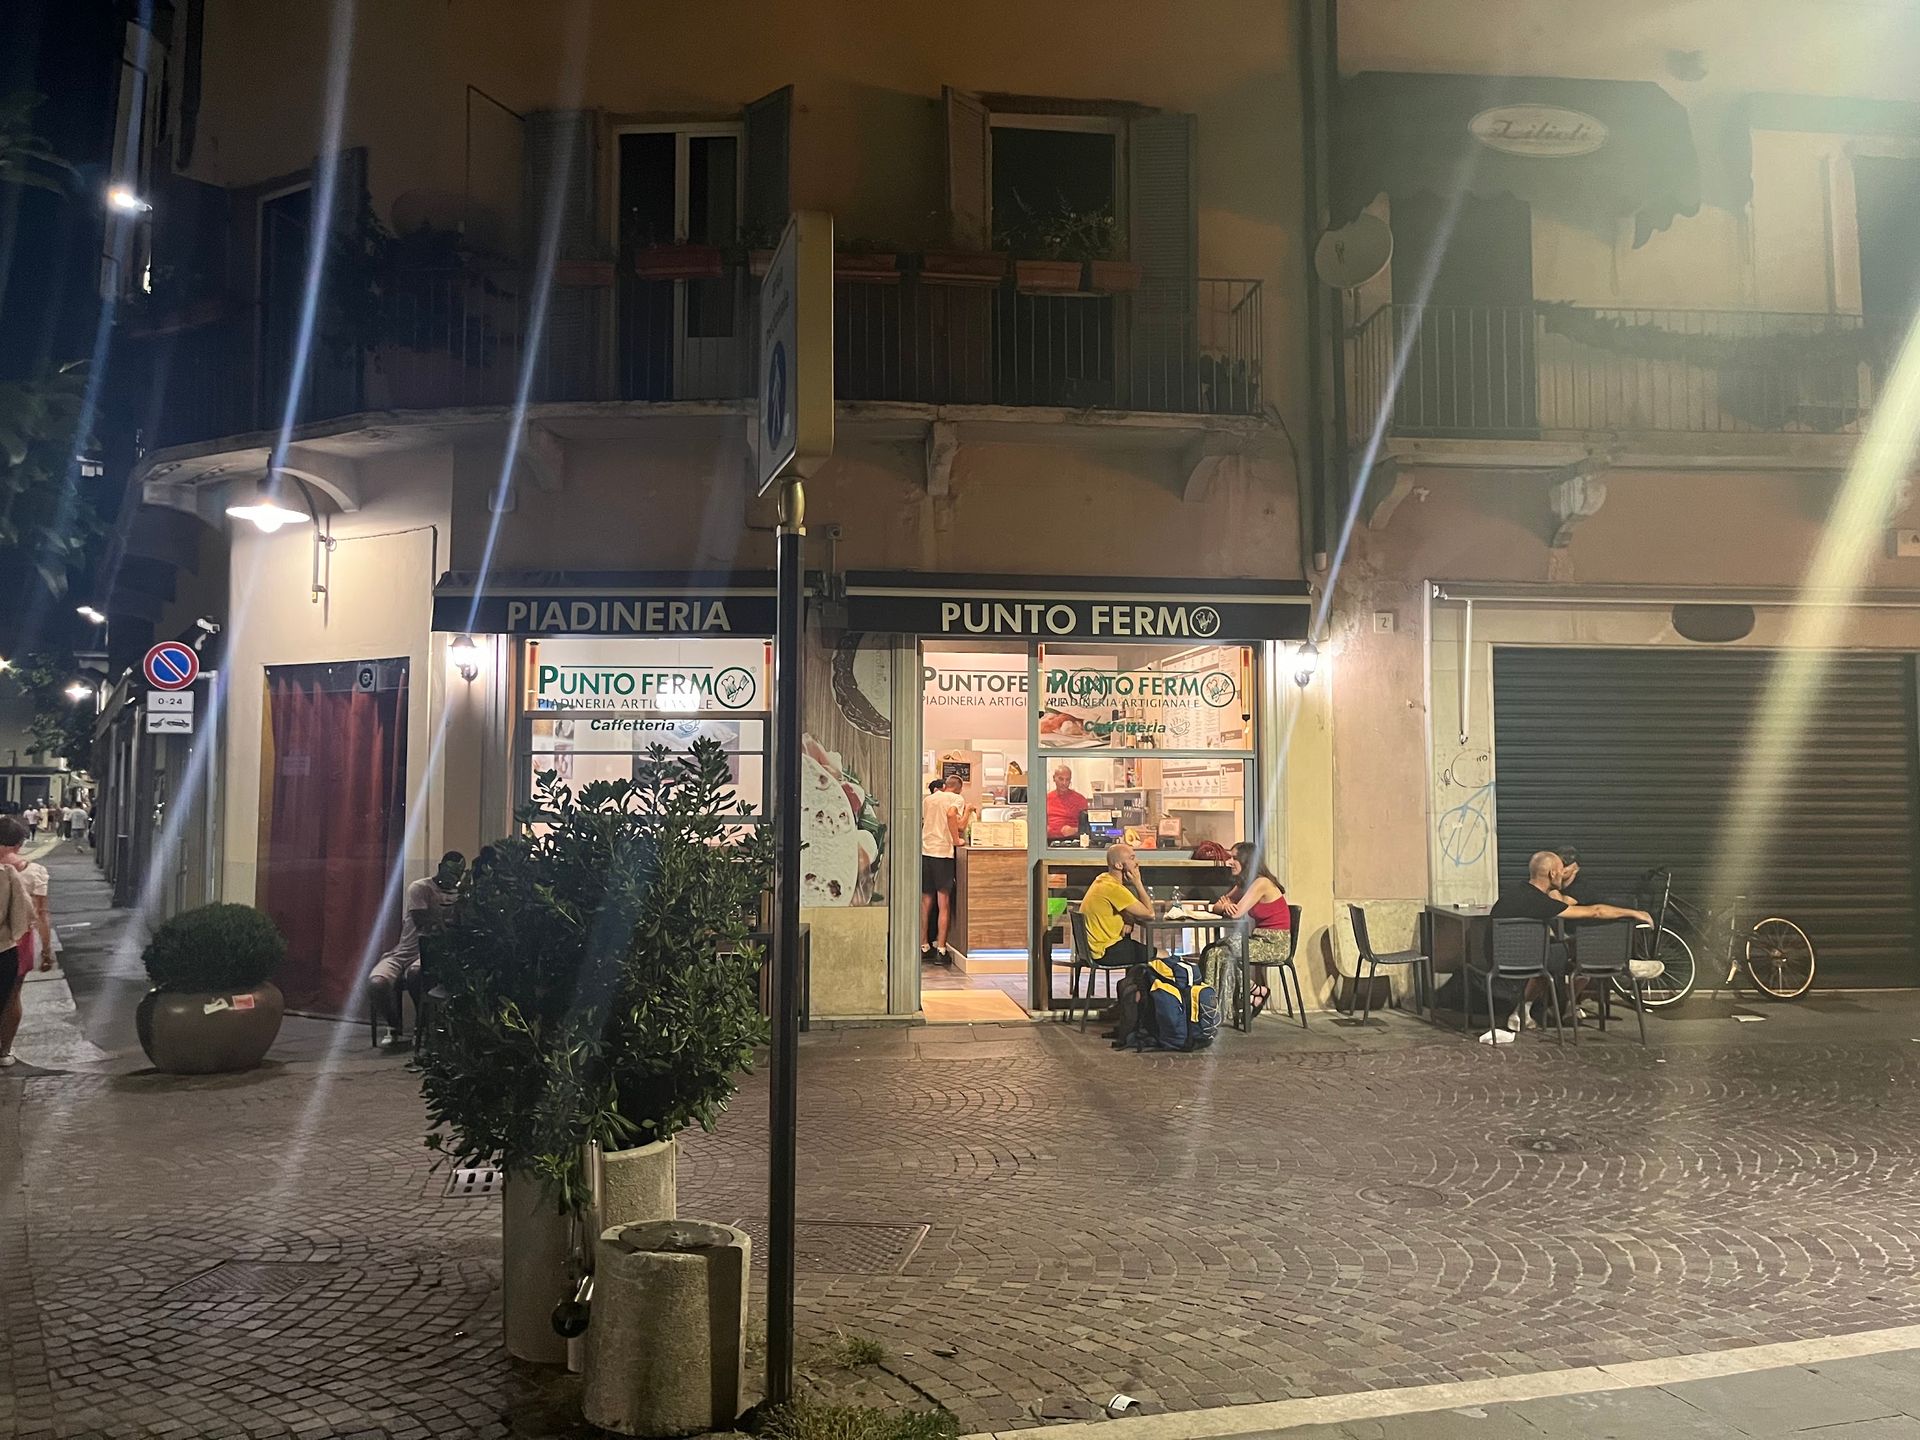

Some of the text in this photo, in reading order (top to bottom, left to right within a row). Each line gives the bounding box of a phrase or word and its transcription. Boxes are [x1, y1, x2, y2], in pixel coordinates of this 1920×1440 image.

[507, 601, 732, 632] PIADINERIA
[941, 602, 1077, 635] PUNTO
[539, 665, 635, 695] PUNTO
[158, 697, 182, 705] 0-24
[538, 698, 616, 709] PIADINERIA
[1122, 698, 1200, 708] ARTIGIANALE
[590, 719, 676, 731] Caffetteria
